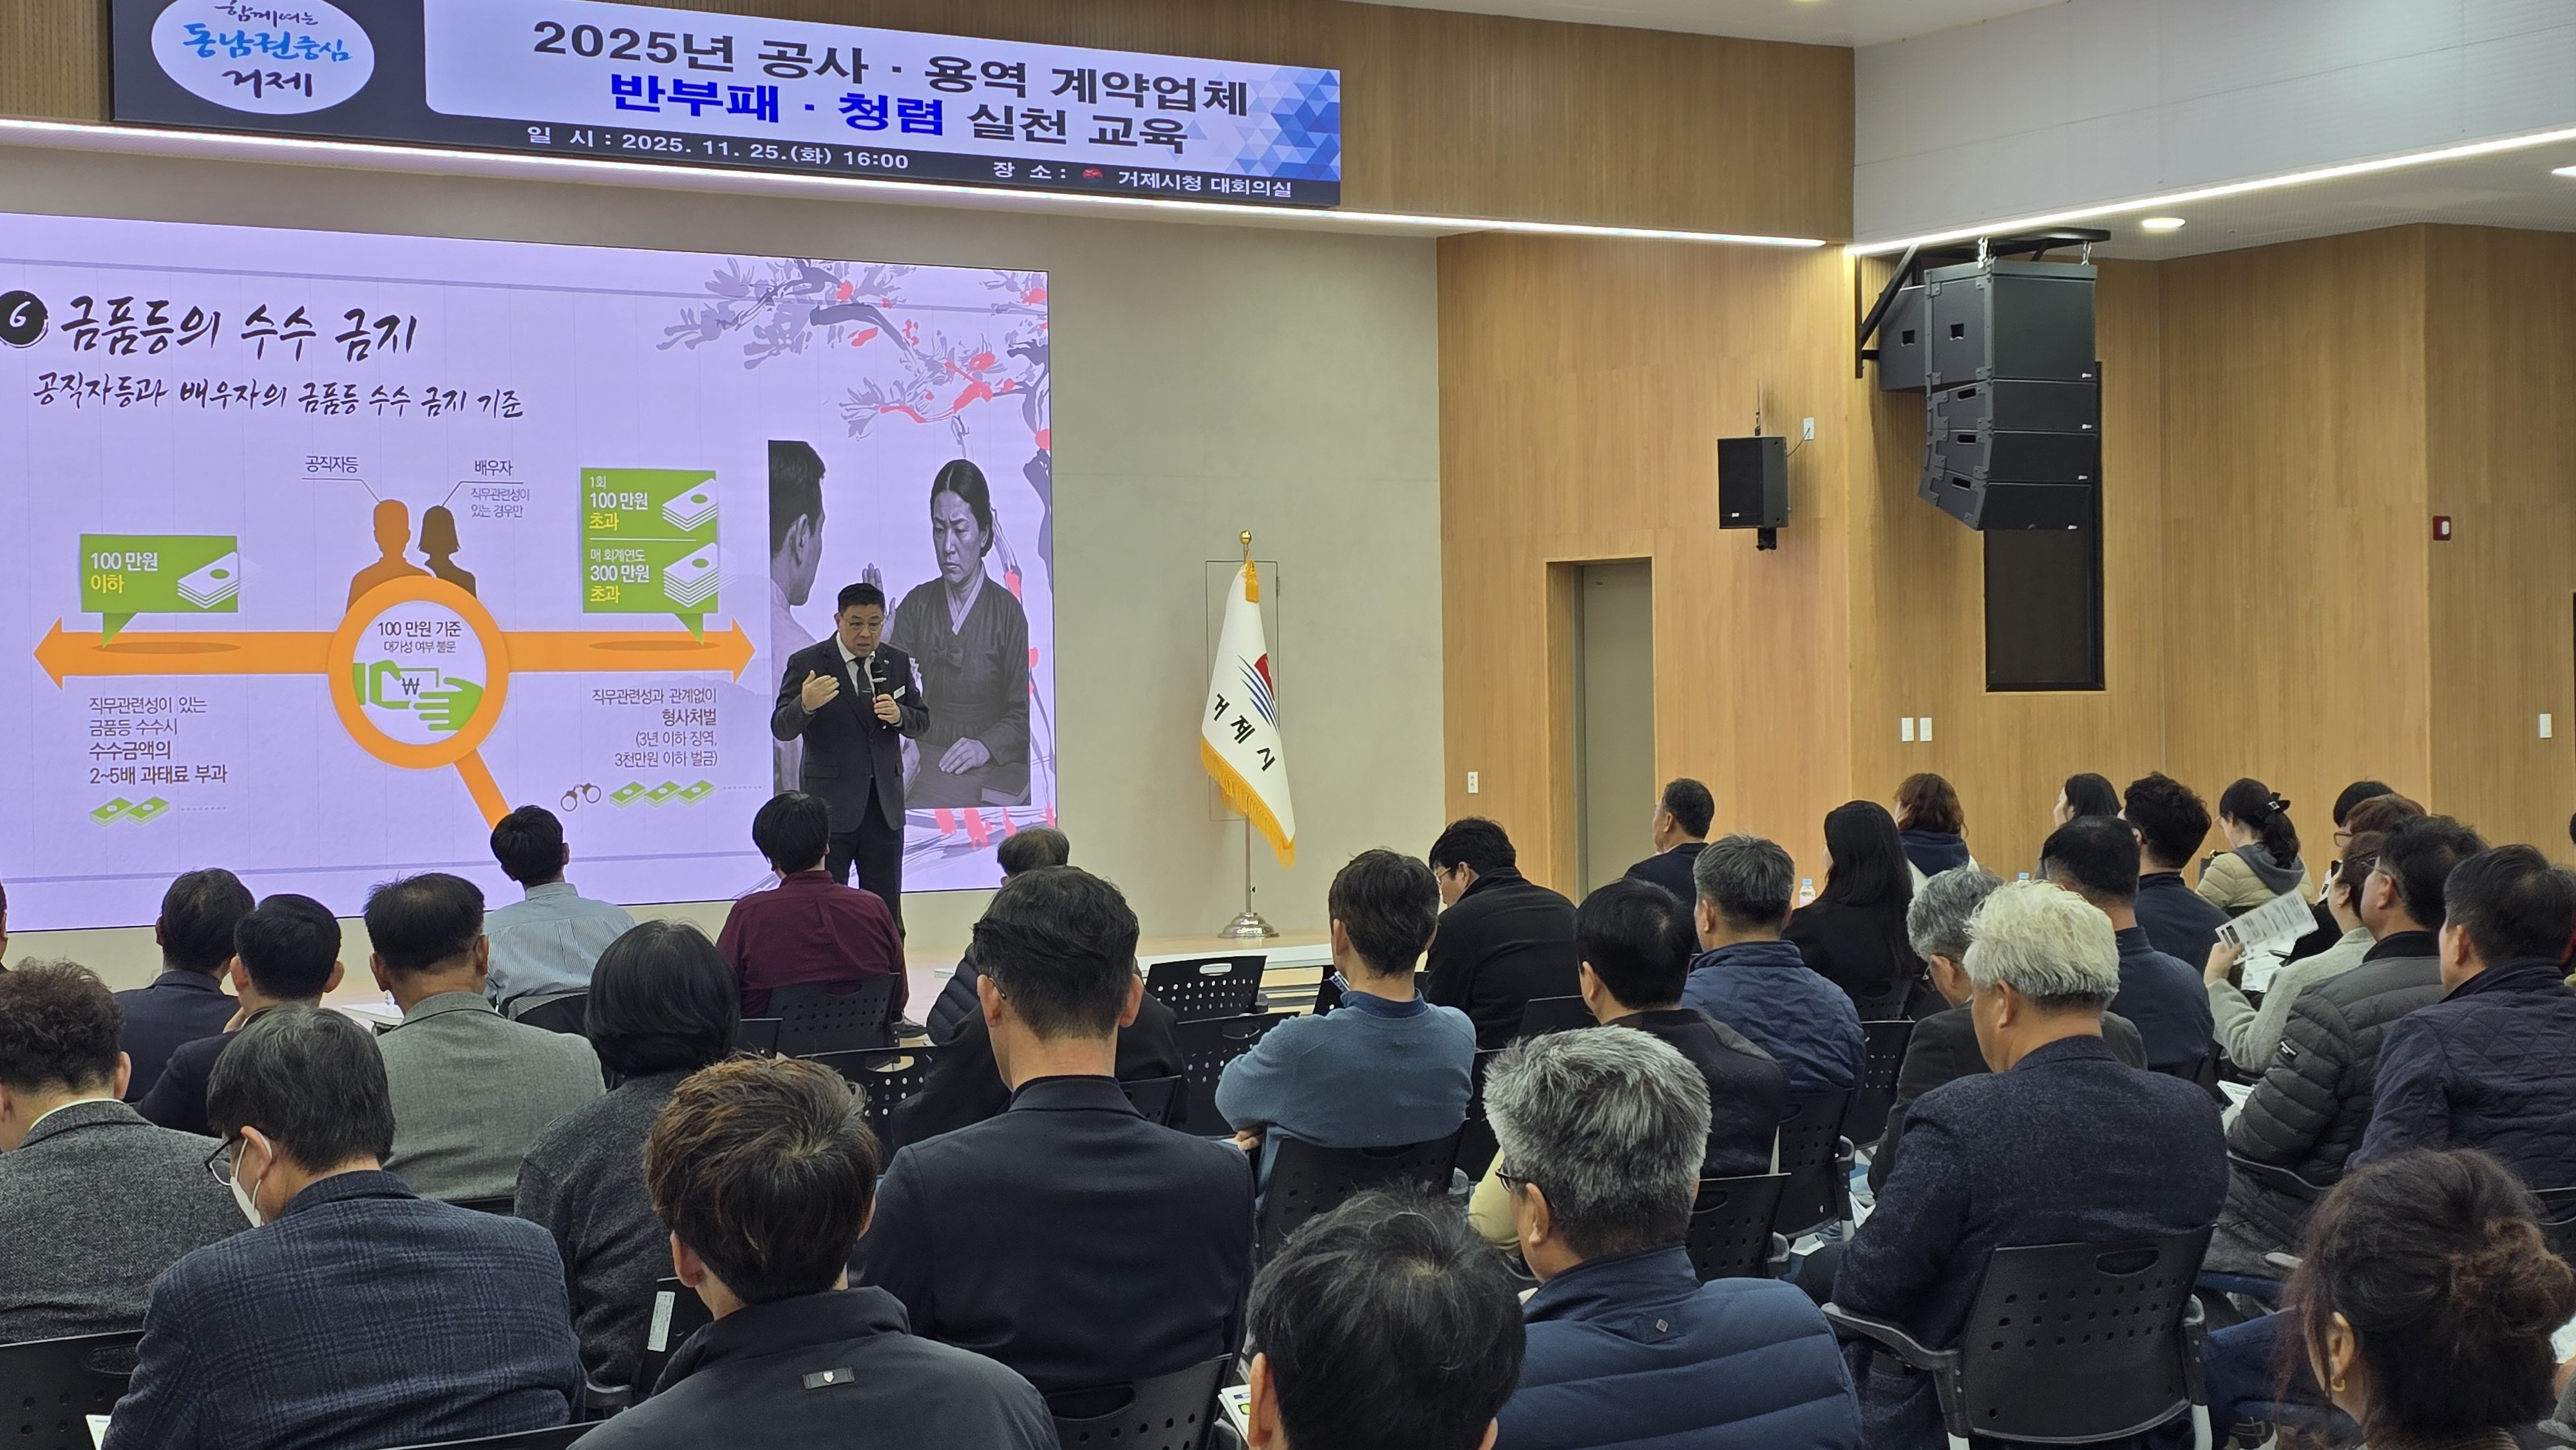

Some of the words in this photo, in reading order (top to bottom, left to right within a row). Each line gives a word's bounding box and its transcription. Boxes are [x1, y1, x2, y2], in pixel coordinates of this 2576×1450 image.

[214, 0, 319, 28] 함께여는
[533, 19, 734, 72] 2025년
[757, 38, 869, 84] 공사
[924, 55, 1027, 98] 용역
[1050, 66, 1248, 117] 계약업체
[222, 68, 313, 99] 거제
[611, 73, 779, 123] 반부패
[838, 92, 944, 136] 청렴
[967, 102, 1066, 146] 실천
[1089, 114, 1188, 154] 교육
[527, 124, 553, 144] 일
[622, 134, 692, 152] 2025.
[703, 139, 741, 156] 11.
[750, 143, 832, 165] 25.(화)
[842, 151, 909, 169] 16:00
[992, 161, 1016, 180] 장
[1119, 169, 1203, 193] 거제시청
[1211, 177, 1293, 198] 대회의실
[10, 301, 31, 327] 6
[61, 296, 221, 355] 금품등의
[241, 303, 317, 362] 수수
[334, 308, 417, 362] 금지
[33, 372, 169, 408] 공직자등과
[180, 379, 288, 410] 배우자의
[298, 381, 361, 415] 금품등
[368, 384, 412, 417] 수수
[421, 386, 467, 419] 금지
[477, 388, 524, 419] 기준
[305, 455, 359, 473] 공직자등
[474, 459, 513, 476] 배우자
[589, 475, 607, 489] 1회
[471, 487, 530, 502] 직무관련성이
[589, 493, 616, 508] 100
[620, 492, 649, 511] 만원
[471, 504, 491, 519] 있는
[494, 505, 524, 519] 경우만
[589, 512, 620, 531] 초과
[90, 552, 122, 570] 100
[126, 552, 158, 572] 만원
[590, 548, 601, 561] 매
[603, 548, 645, 562] 회계연도
[590, 565, 618, 581] 300
[621, 564, 650, 583] 만원
[90, 574, 124, 594] 이하
[590, 585, 620, 603] 초과
[378, 621, 402, 636] 100
[405, 621, 431, 637] 만원
[436, 621, 462, 637] 기준
[384, 641, 413, 654] 대가성
[415, 641, 435, 654] 여부
[592, 688, 665, 704] 직무관련성과
[669, 688, 717, 704] 관계없이
[88, 697, 173, 715] 직무관련성이
[178, 697, 207, 713] 있는
[662, 708, 717, 726] 형사처벌
[88, 719, 131, 737] 금품등
[135, 719, 178, 736] 수수시
[1214, 693, 1276, 771] 거제시
[636, 731, 659, 748] (3년
[663, 731, 688, 746] 이하
[690, 730, 717, 747] 징역,
[89, 740, 171, 760] 수수금액의
[615, 751, 659, 767] 3천만원
[663, 750, 688, 767] 이하
[691, 749, 718, 767] 벌금)
[90, 766, 137, 785] 2~5배
[140, 766, 190, 785] 과태료
[194, 764, 228, 784] 부과
